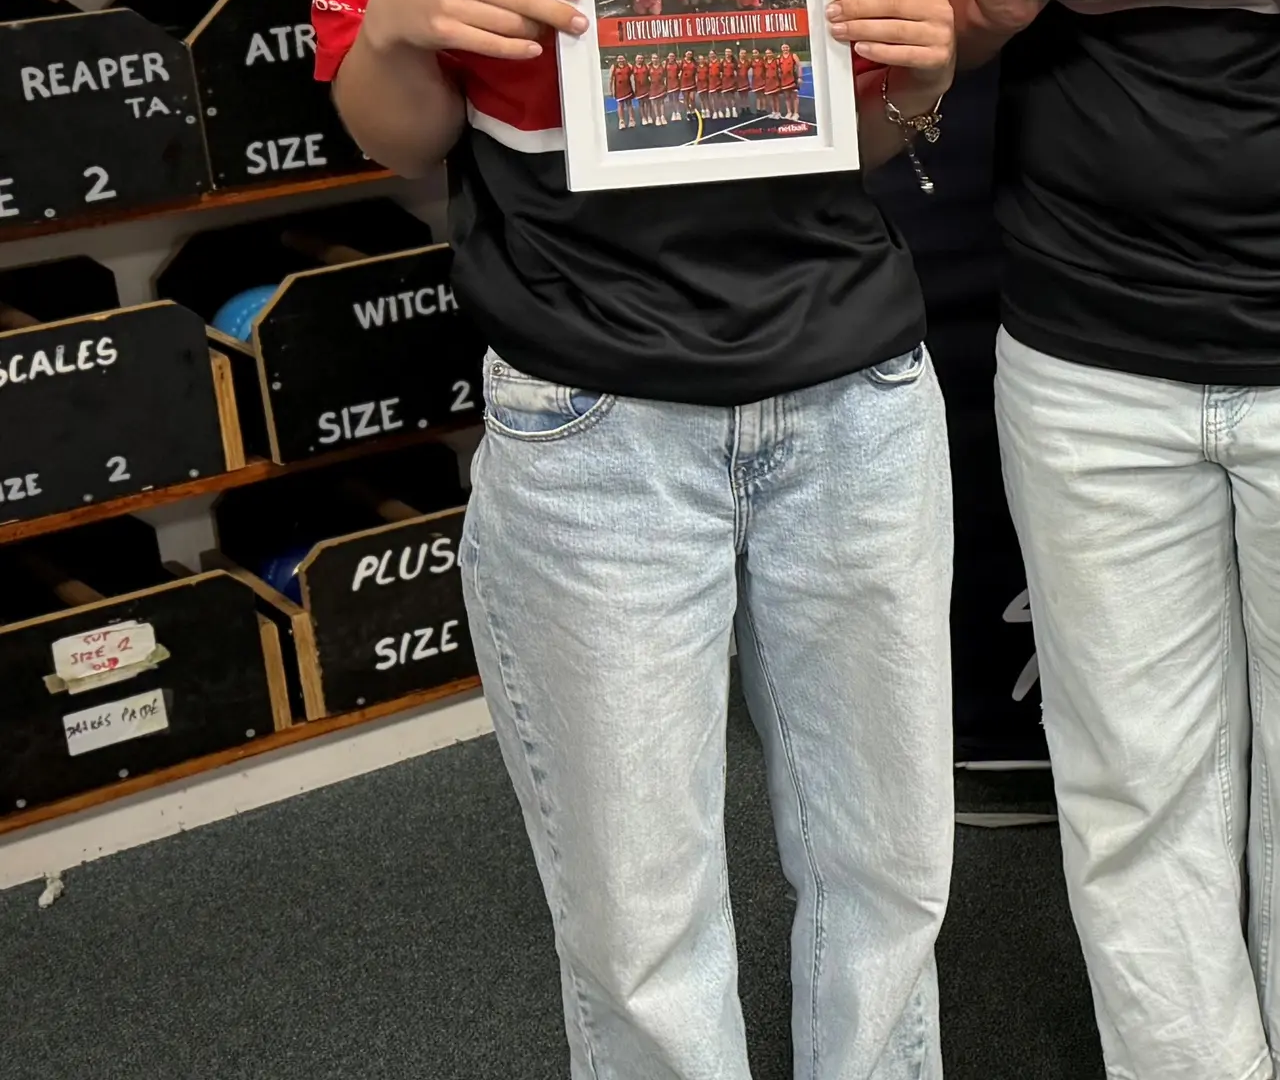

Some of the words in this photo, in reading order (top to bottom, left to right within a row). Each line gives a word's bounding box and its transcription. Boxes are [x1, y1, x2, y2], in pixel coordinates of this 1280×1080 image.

[626, 20, 683, 41] DEVELOPMENT
[695, 14, 762, 36] REPRESENTATIVE
[765, 12, 798, 33] NETBALL
[20, 51, 170, 102] REAPER
[246, 133, 327, 176] SIZE
[82, 165, 117, 203] 2
[318, 398, 403, 444] SIZE
[449, 380, 473, 412] 2
[105, 456, 131, 482] 2
[375, 620, 460, 671] SIZE
